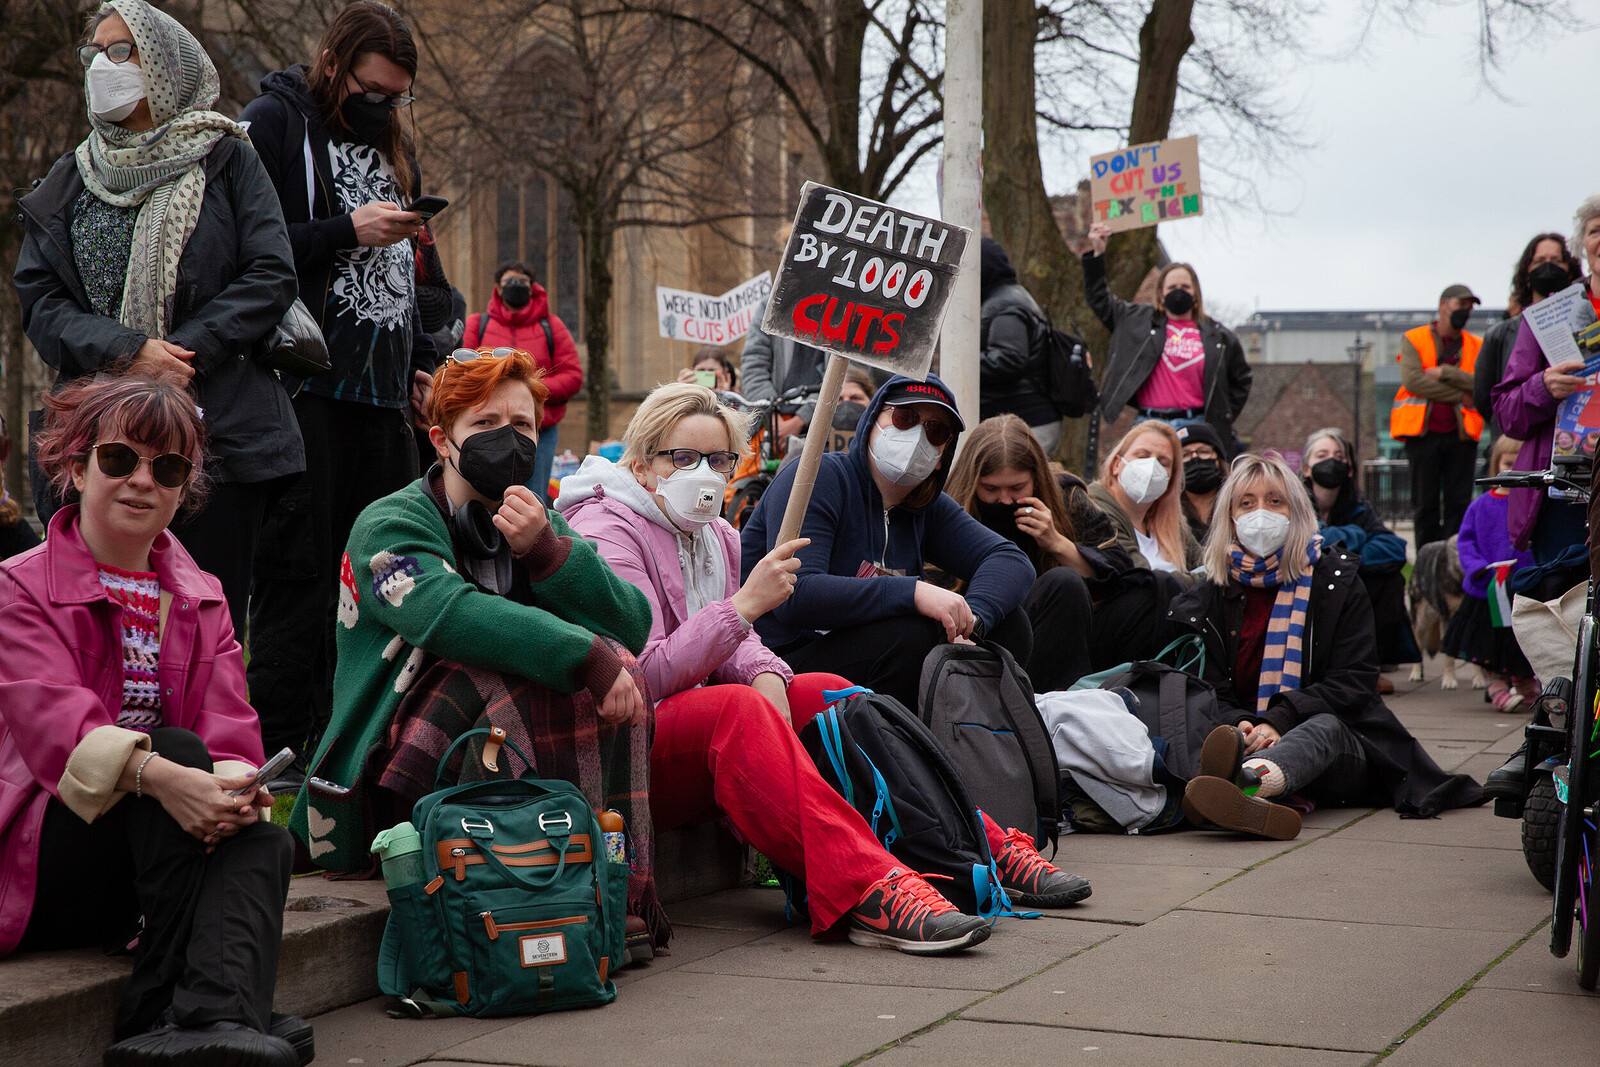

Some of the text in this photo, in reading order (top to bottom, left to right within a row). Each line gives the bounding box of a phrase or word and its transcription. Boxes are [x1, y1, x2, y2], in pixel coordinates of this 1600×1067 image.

[1109, 162, 1182, 195] CUT US
[1095, 182, 1199, 223] TAX THE RICH
[813, 193, 949, 263] DEATH
[793, 233, 934, 309] BY 1000
[699, 300, 721, 320] NOT
[792, 294, 906, 355] CUTS
[684, 318, 723, 342] CUTS
[532, 952, 558, 960] SEVENTEEN
